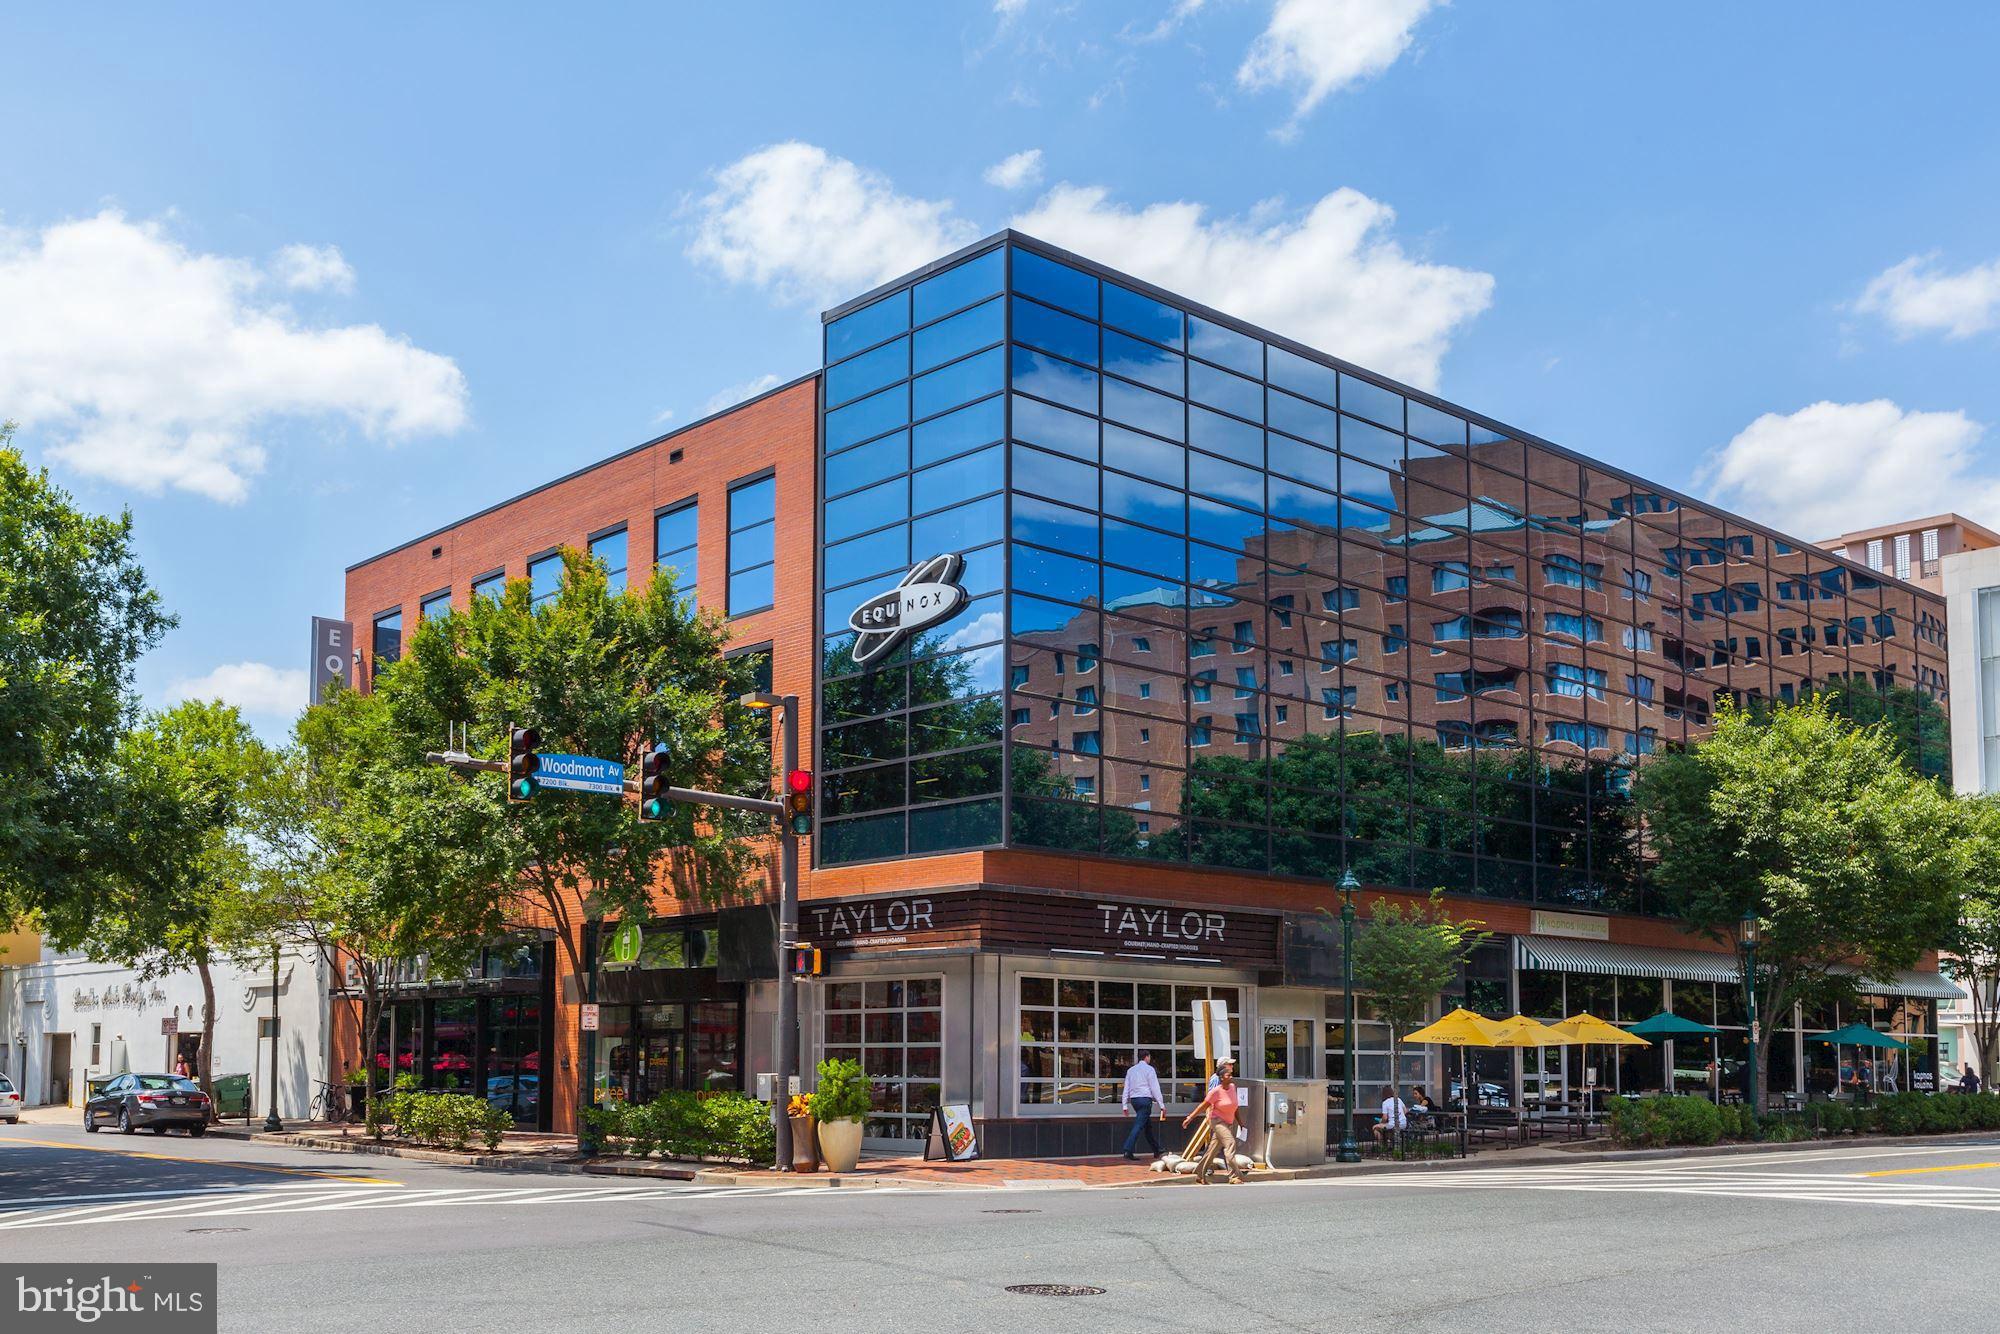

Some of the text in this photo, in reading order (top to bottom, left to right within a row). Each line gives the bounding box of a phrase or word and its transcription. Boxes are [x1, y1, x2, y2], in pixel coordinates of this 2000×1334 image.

[862, 591, 942, 624] EQUINOX
[541, 756, 620, 779] Woodmont Av
[542, 777, 557, 786] 7200
[588, 782, 603, 791] 7300
[811, 899, 935, 937] TAYLOR
[1097, 904, 1226, 942] TAYLOR
[1264, 1024, 1287, 1034] 7280
